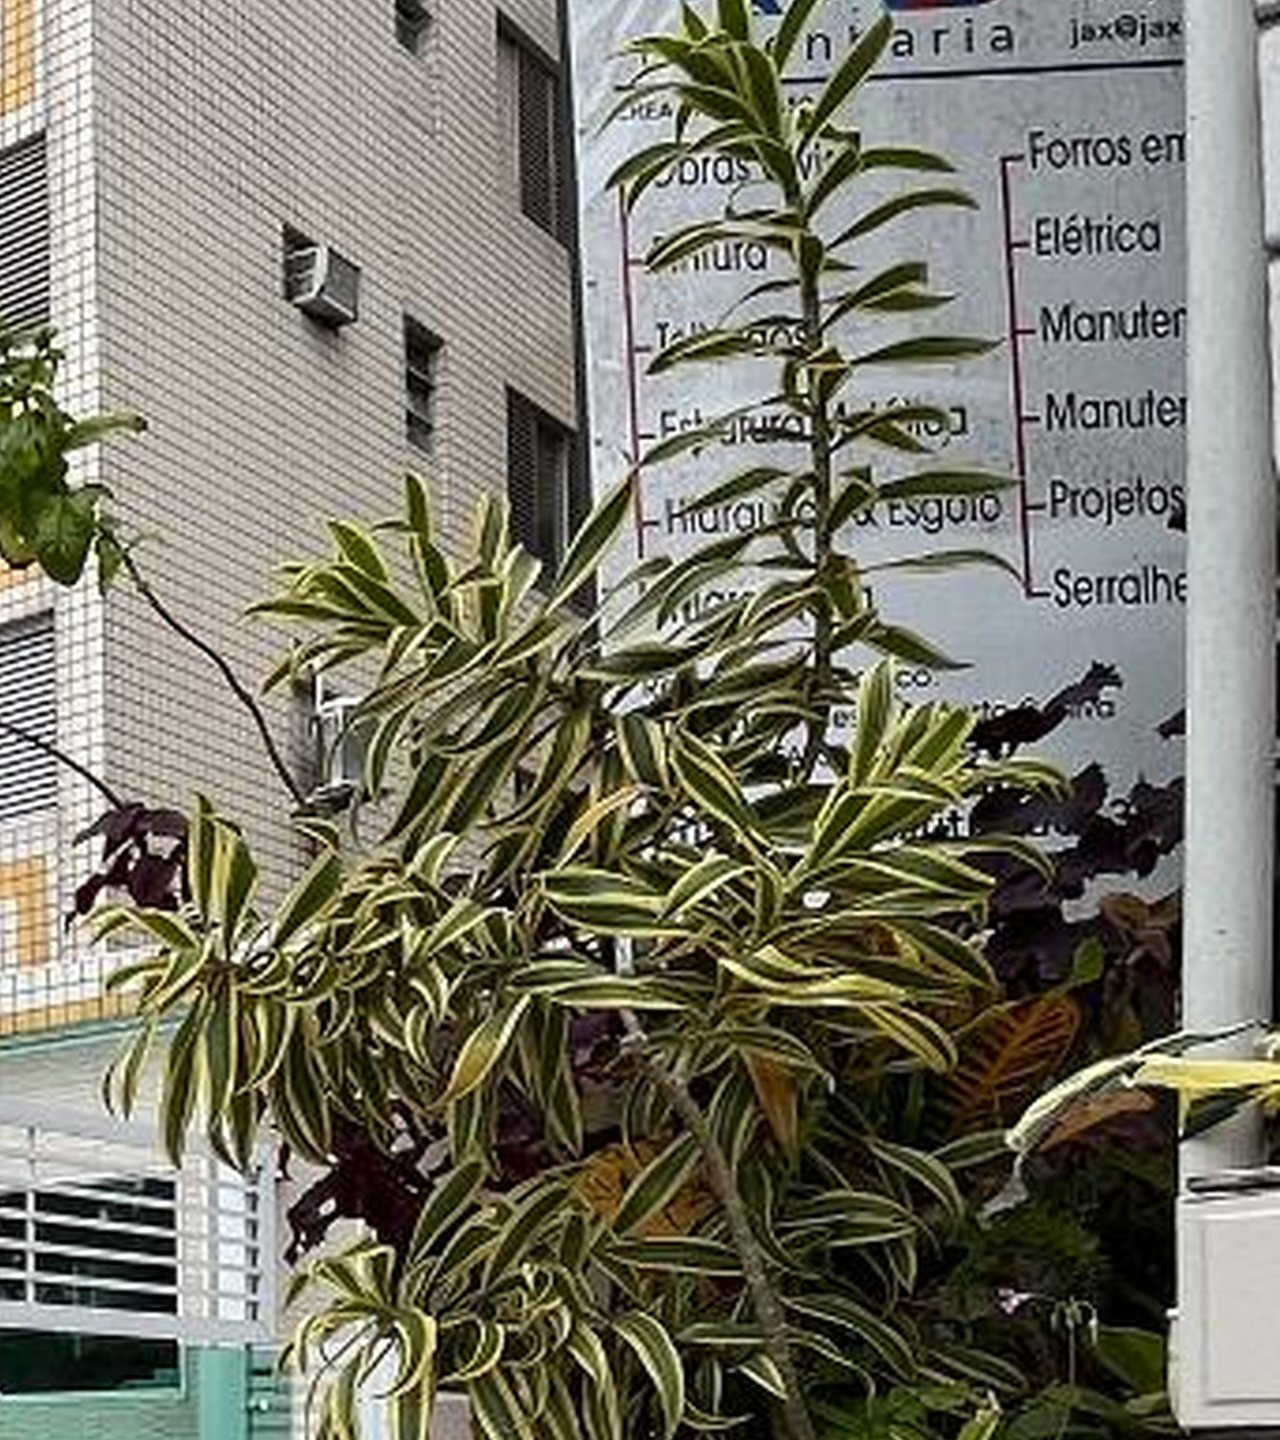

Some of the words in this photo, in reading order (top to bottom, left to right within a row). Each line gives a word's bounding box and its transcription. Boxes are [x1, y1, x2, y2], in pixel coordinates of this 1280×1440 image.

[1070, 14, 1183, 50] jax@jax
[1028, 130, 1132, 170] Forros
[1036, 214, 1162, 256] Elétrica
[1042, 300, 1186, 343] Manute
[1046, 389, 1186, 431] Manute
[1054, 564, 1186, 608] Serralhe
